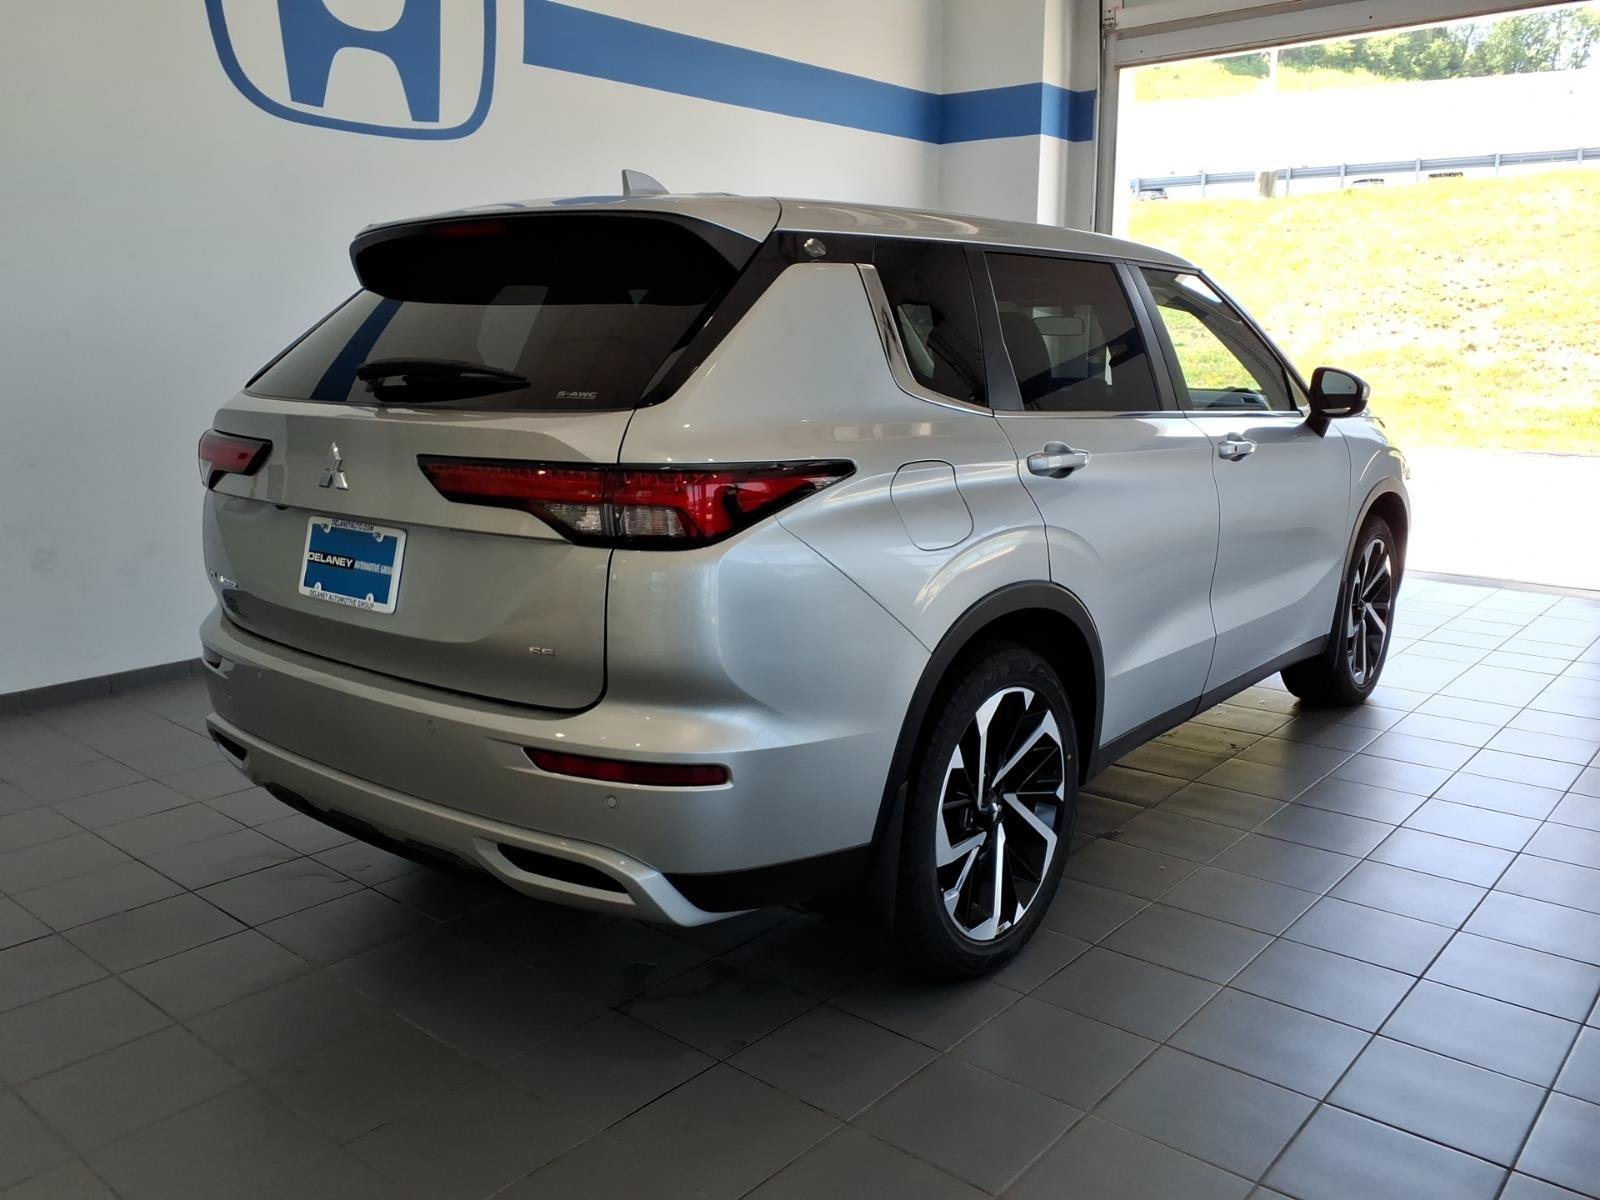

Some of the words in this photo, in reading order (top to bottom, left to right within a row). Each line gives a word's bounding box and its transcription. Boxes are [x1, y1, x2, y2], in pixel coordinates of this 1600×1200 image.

[555, 391, 598, 399] S-AWC
[307, 552, 353, 567] DELANEY
[354, 560, 380, 573] AUTOMOTIVE
[308, 589, 327, 600] DELANEY
[327, 593, 357, 606] AUTOMOTIVE
[357, 599, 375, 610] GROUP
